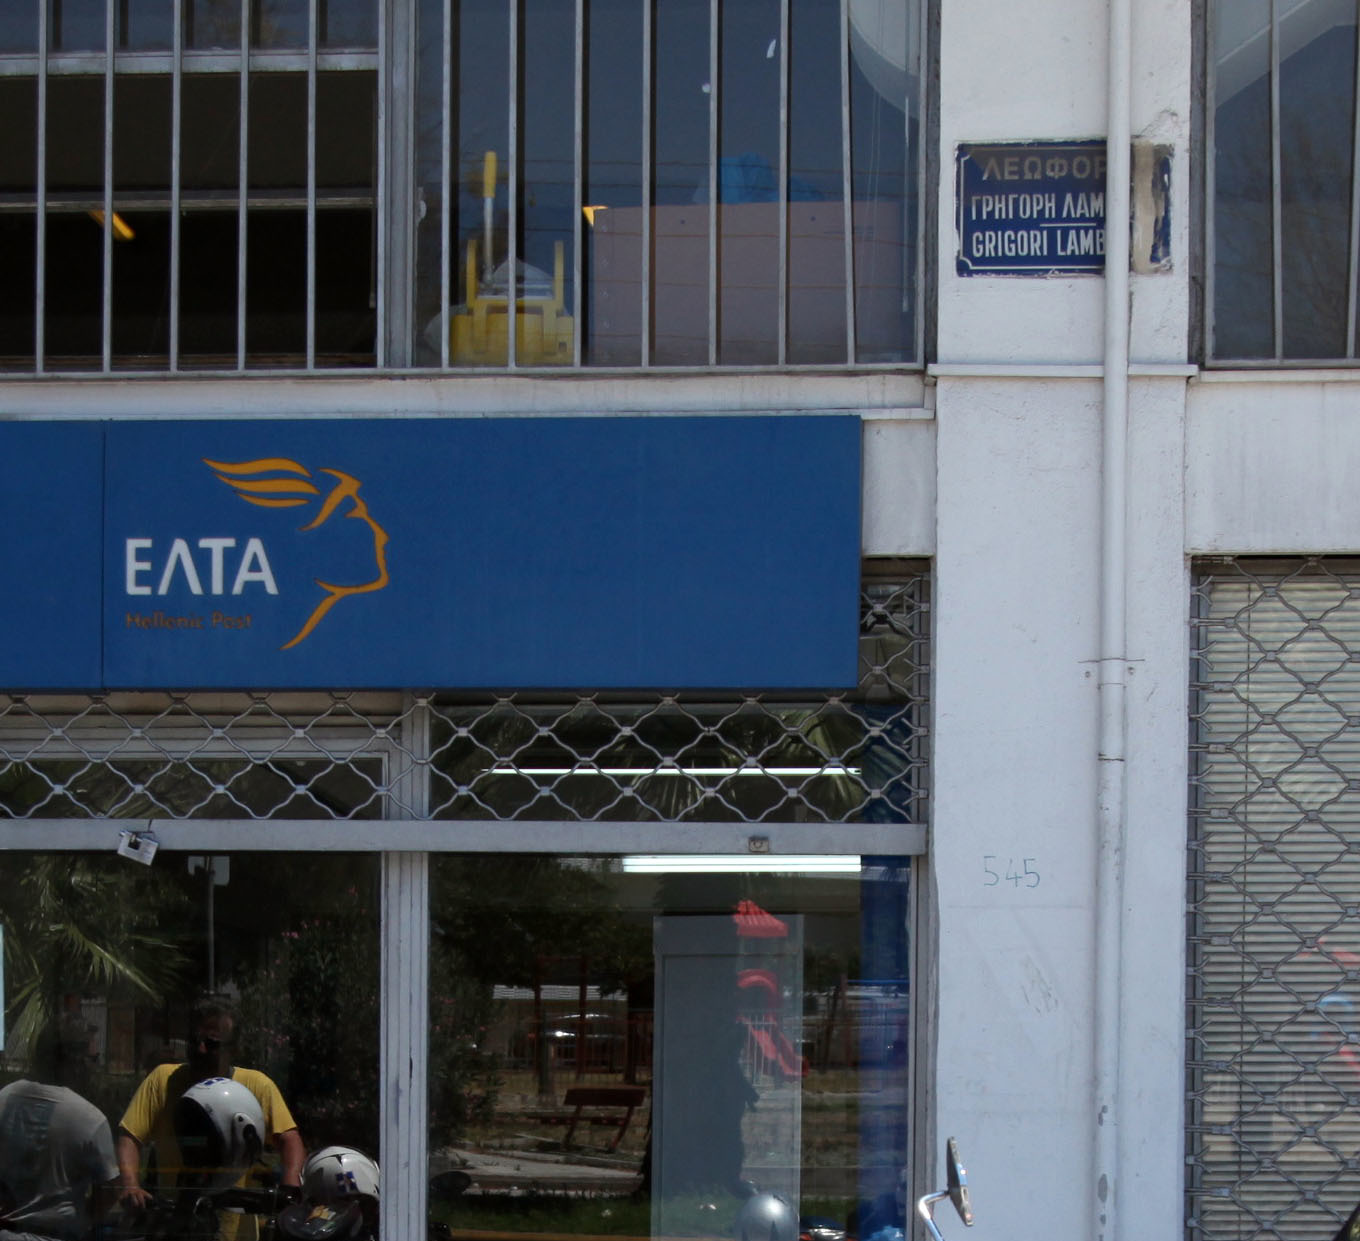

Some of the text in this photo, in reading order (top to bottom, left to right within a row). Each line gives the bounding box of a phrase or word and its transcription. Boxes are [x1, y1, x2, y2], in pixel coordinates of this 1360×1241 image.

[982, 156, 1107, 181] ΛΕΩΦΟΡ
[971, 192, 1105, 220] ΓΡΗΓΟΡΗ ΛΑΜ
[972, 229, 1107, 258] GRIGORI LAMB
[126, 537, 279, 595] ΕΛΤΑ
[126, 610, 252, 630] Hellenic Post
[983, 855, 1040, 888] 545
